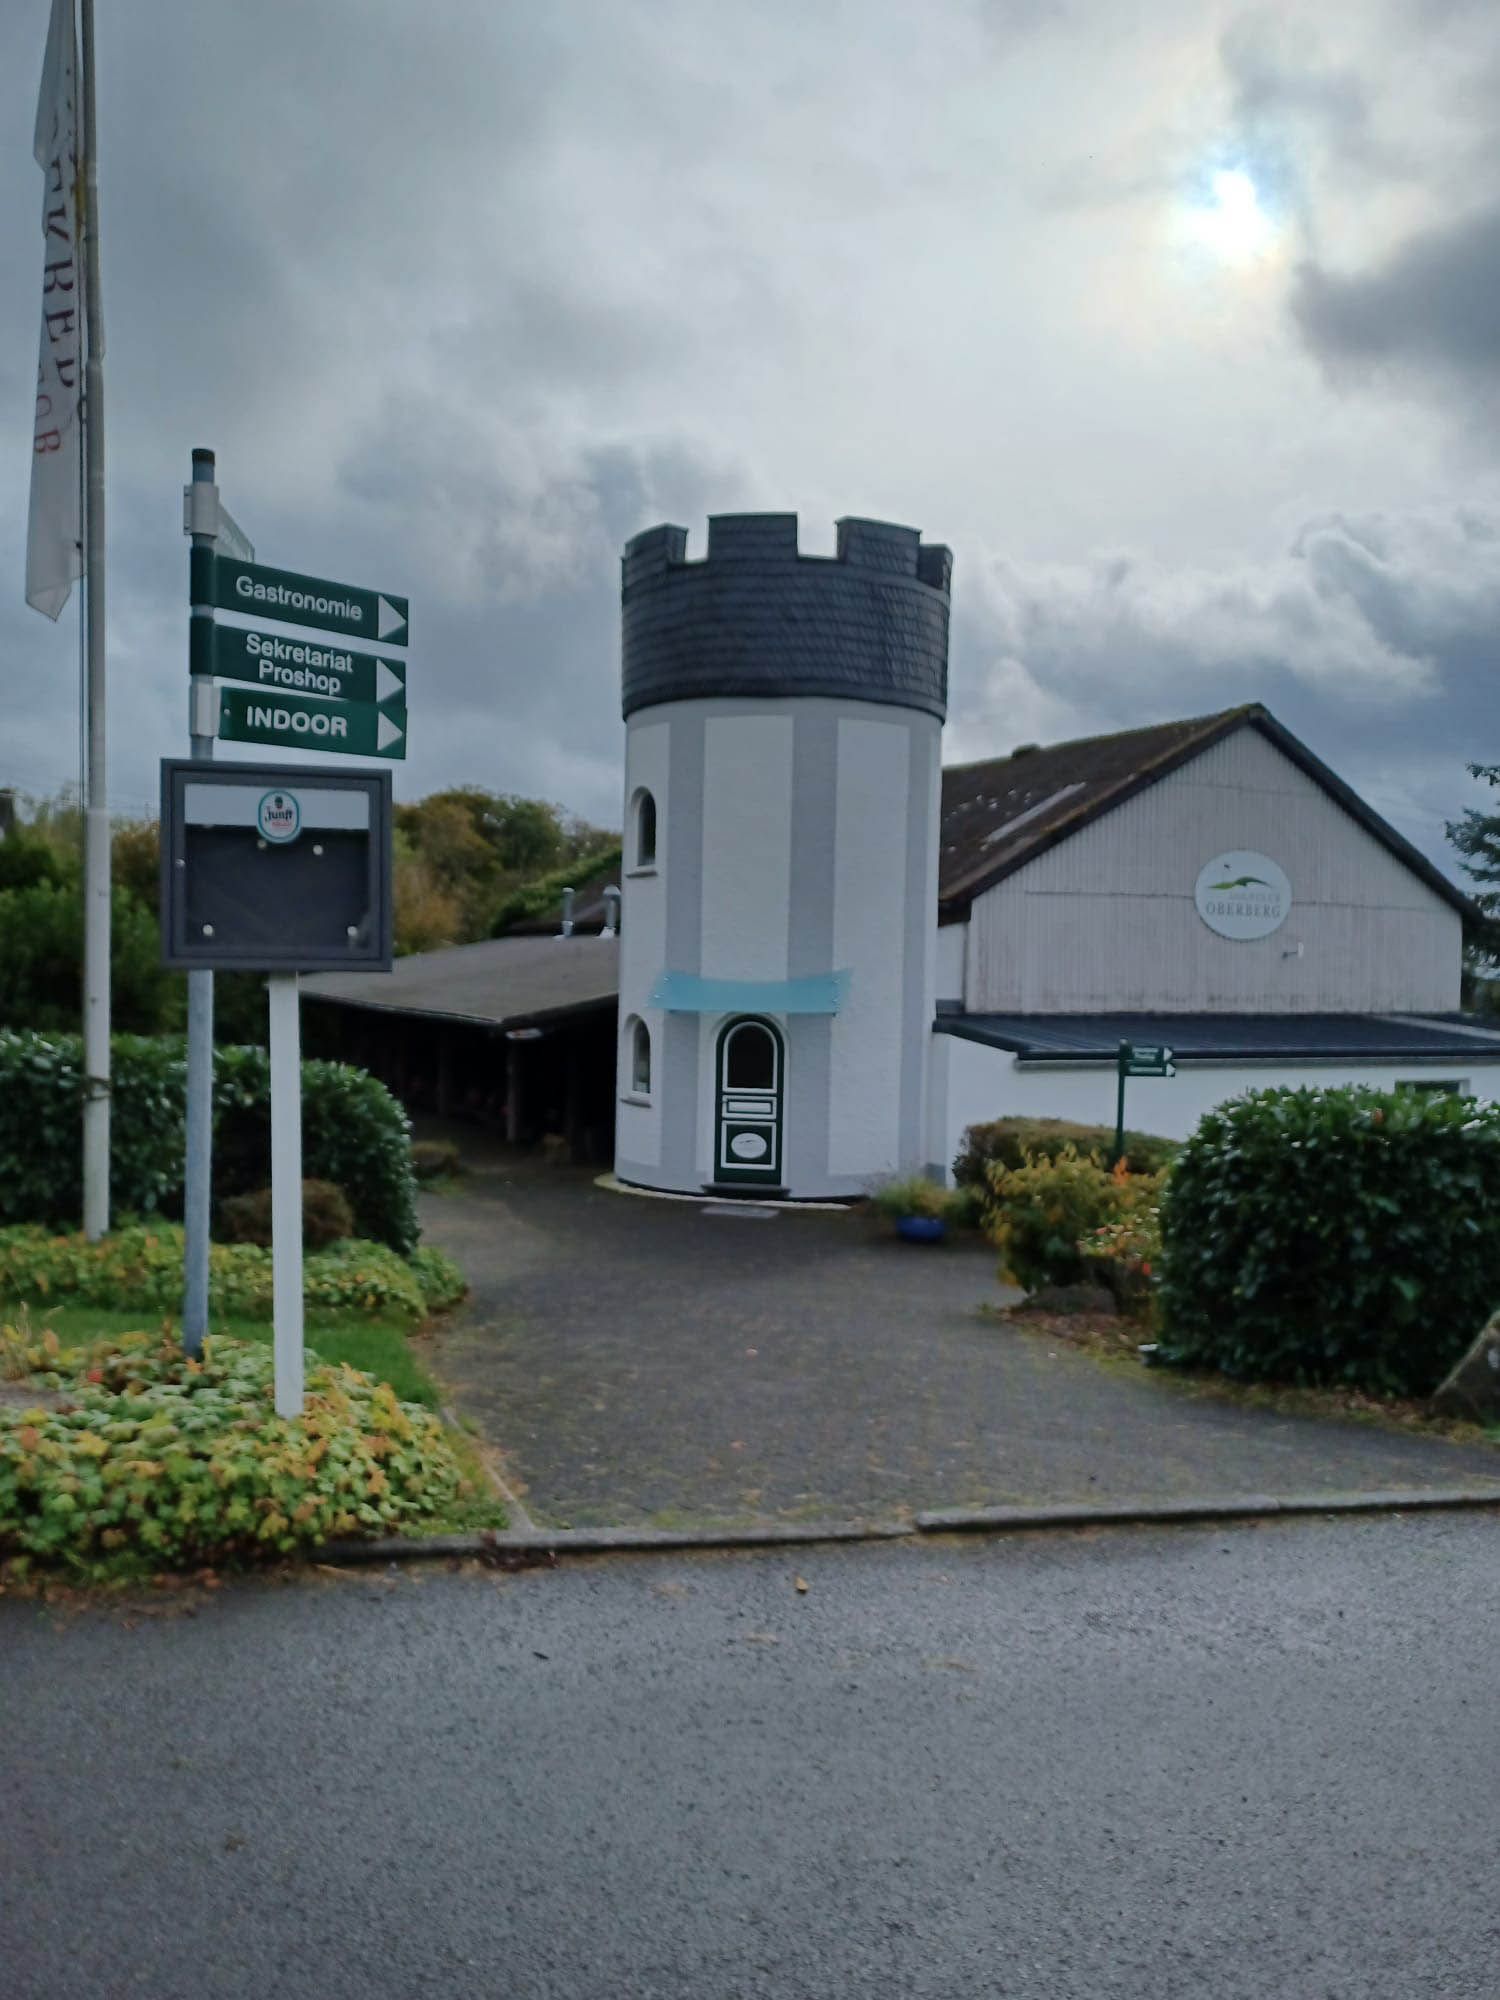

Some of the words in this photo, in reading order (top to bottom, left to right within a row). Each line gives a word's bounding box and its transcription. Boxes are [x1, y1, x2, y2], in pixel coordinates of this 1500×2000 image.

[236, 575, 363, 621] Gastronomie
[246, 633, 353, 673] Sekretariat
[259, 659, 342, 696] Proshop
[246, 705, 348, 737] INDOOR
[1206, 902, 1281, 919] OBERBERG
